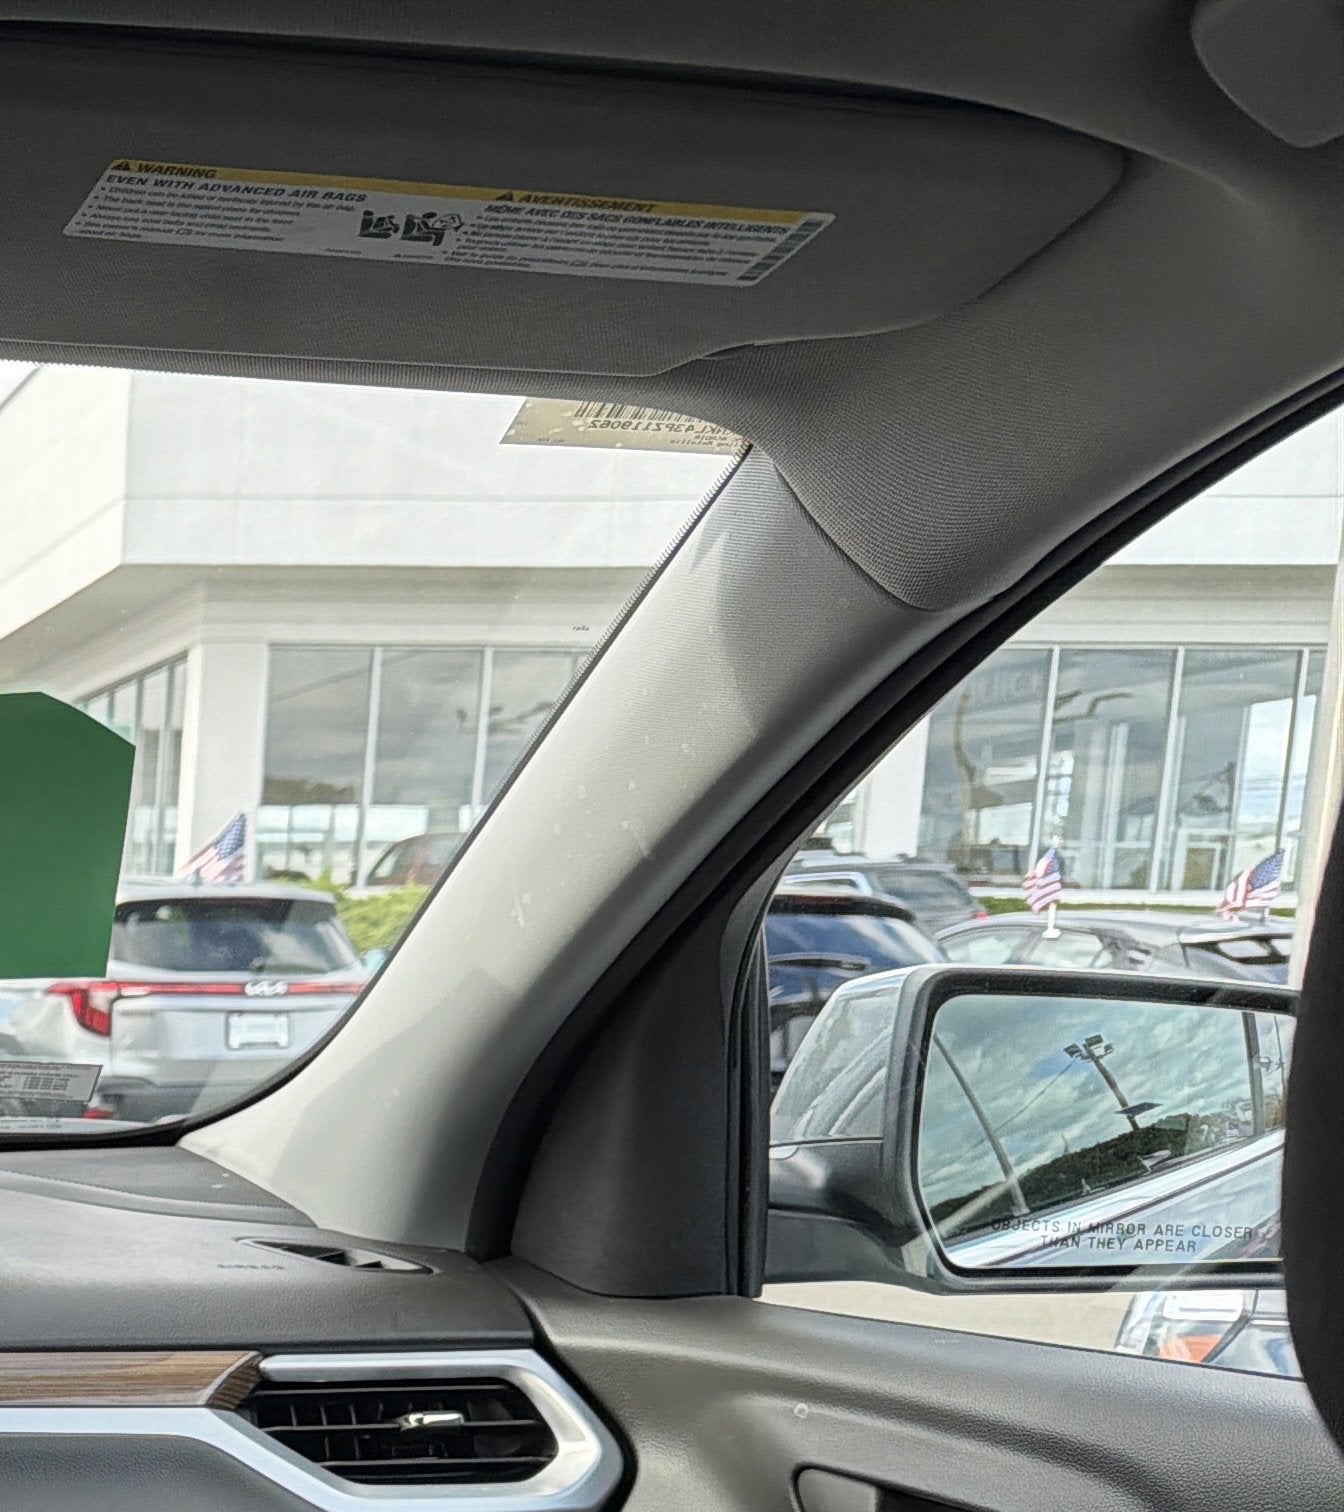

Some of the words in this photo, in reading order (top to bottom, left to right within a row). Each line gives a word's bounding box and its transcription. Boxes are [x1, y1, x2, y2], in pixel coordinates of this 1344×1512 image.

[138, 163, 217, 178] WARNING
[106, 174, 148, 185] EVEN
[153, 178, 195, 190] WITH
[198, 181, 285, 197] ADVANCED
[289, 189, 319, 199] AIR
[322, 191, 368, 202] BAGS
[991, 1219, 1060, 1233] OBJECTS
[1067, 1221, 1081, 1234] IN
[1088, 1222, 1146, 1235] MIRROR
[1153, 1223, 1184, 1238] ARE
[1191, 1225, 1253, 1240] CLOSER
[1041, 1235, 1080, 1248] THAN
[1090, 1236, 1127, 1249] THEY
[1134, 1238, 1197, 1253] APPEAR
